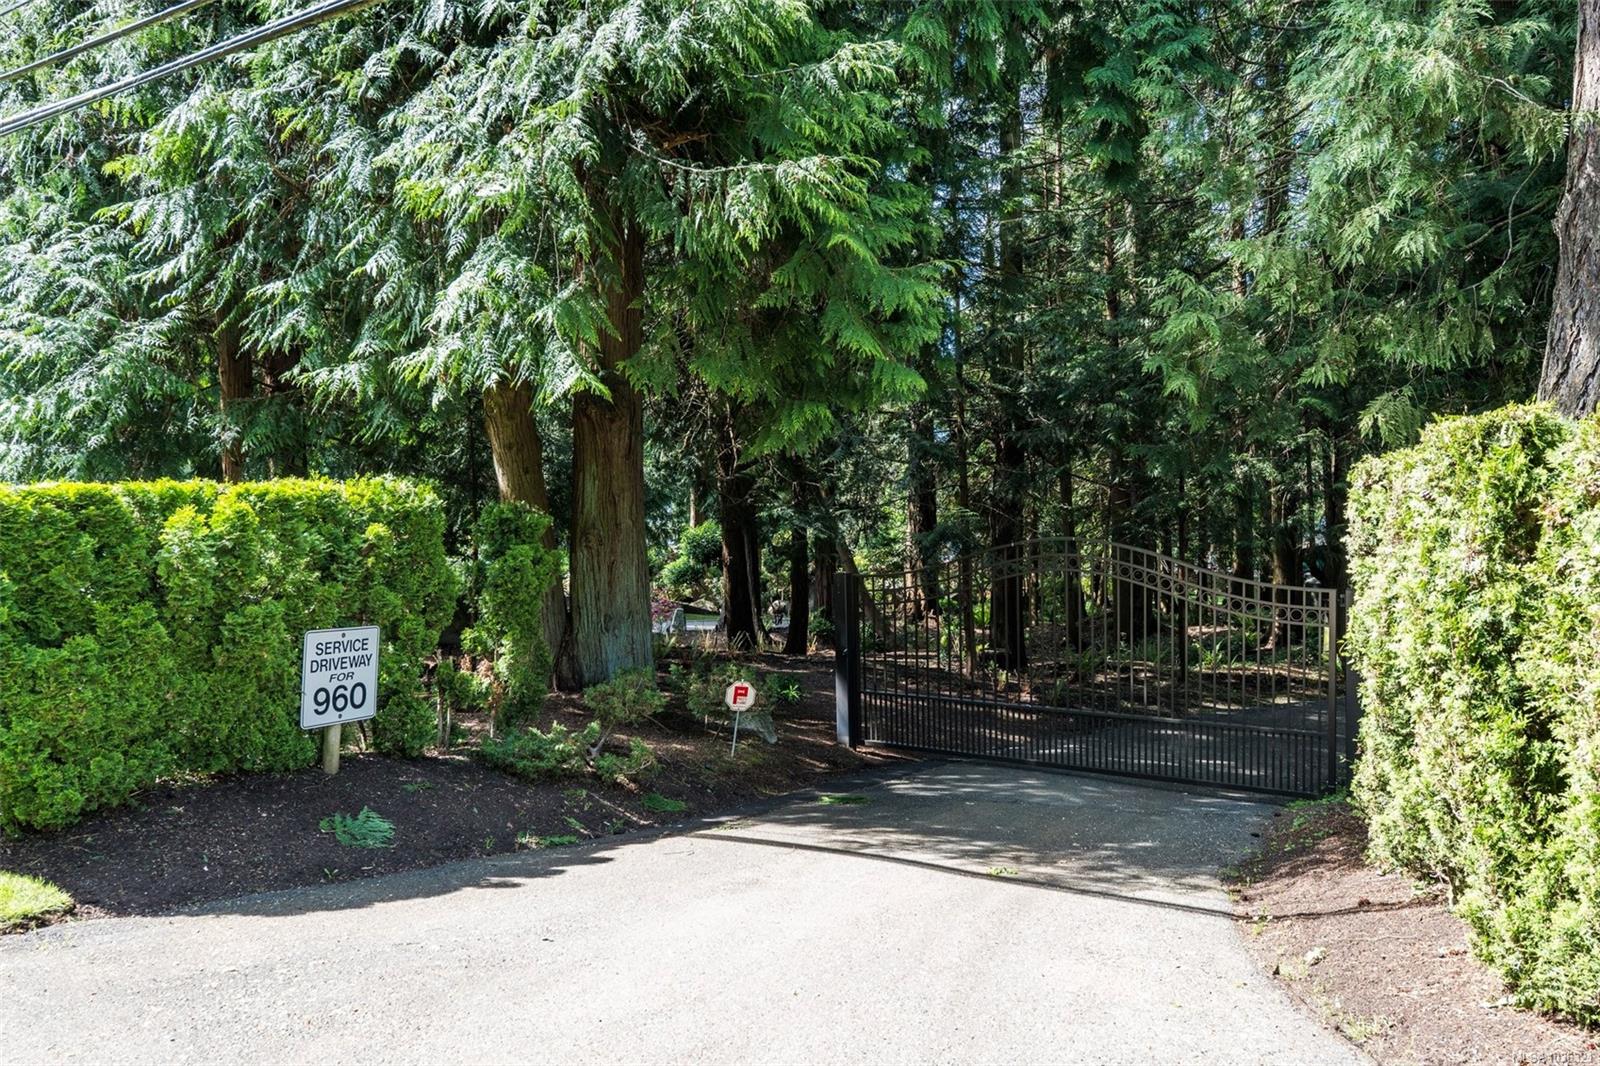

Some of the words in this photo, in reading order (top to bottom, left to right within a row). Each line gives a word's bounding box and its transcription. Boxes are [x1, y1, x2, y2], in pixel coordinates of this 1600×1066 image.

[315, 638, 369, 656] SERVICE
[310, 653, 373, 673] DRIVEWAY
[329, 671, 355, 683] FOR
[313, 681, 367, 716] 960
